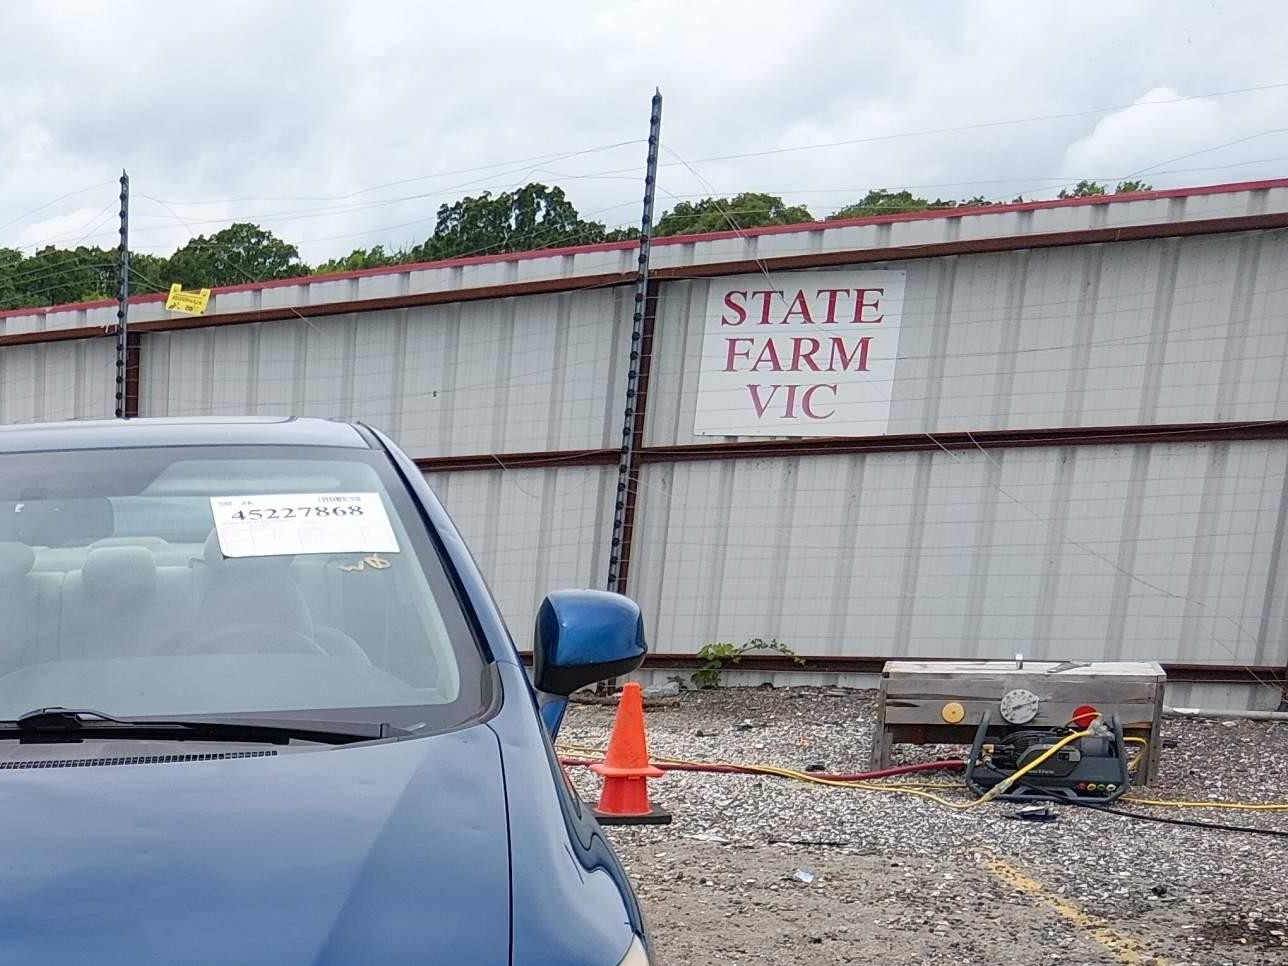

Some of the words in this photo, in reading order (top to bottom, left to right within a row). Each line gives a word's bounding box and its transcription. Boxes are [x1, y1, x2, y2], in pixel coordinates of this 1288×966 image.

[720, 287, 885, 327] STATE
[722, 336, 875, 373] FARM
[746, 383, 838, 420] VIC
[231, 504, 365, 522] 45227868
